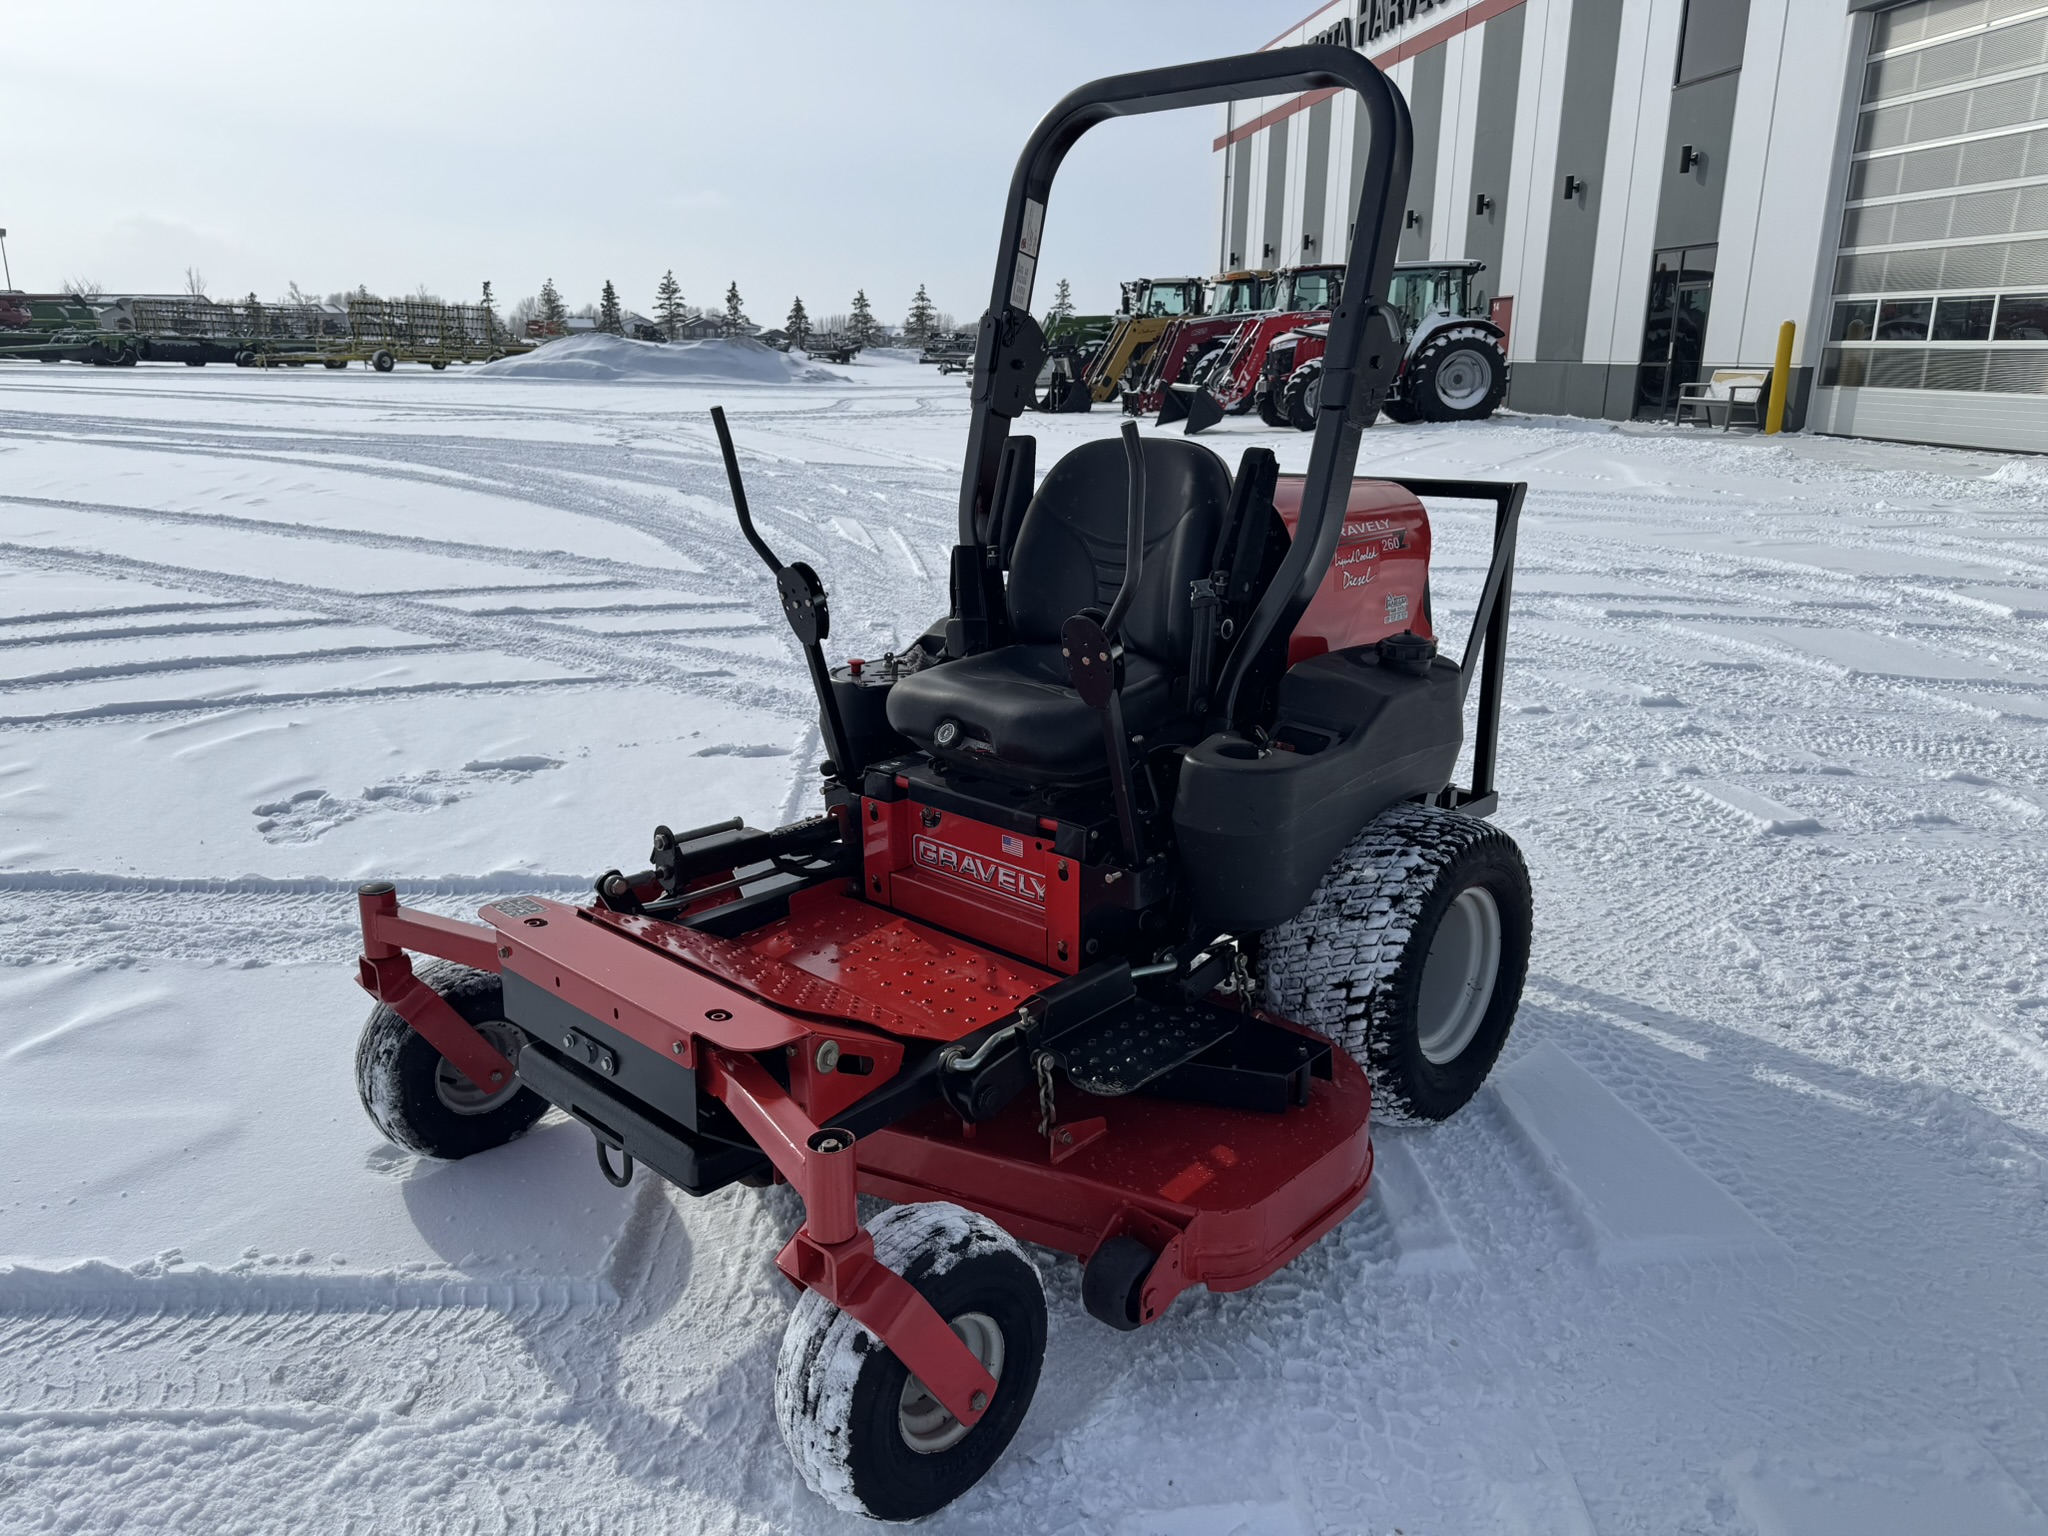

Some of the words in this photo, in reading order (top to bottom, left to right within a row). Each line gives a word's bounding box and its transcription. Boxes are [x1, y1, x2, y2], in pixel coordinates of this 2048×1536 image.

[1493, 302, 1500, 311] 14
[1334, 550, 1355, 570] Liquid
[1355, 546, 1379, 563] Cooled
[1343, 566, 1377, 589] Diesel
[919, 840, 1046, 901] GRAVELY
